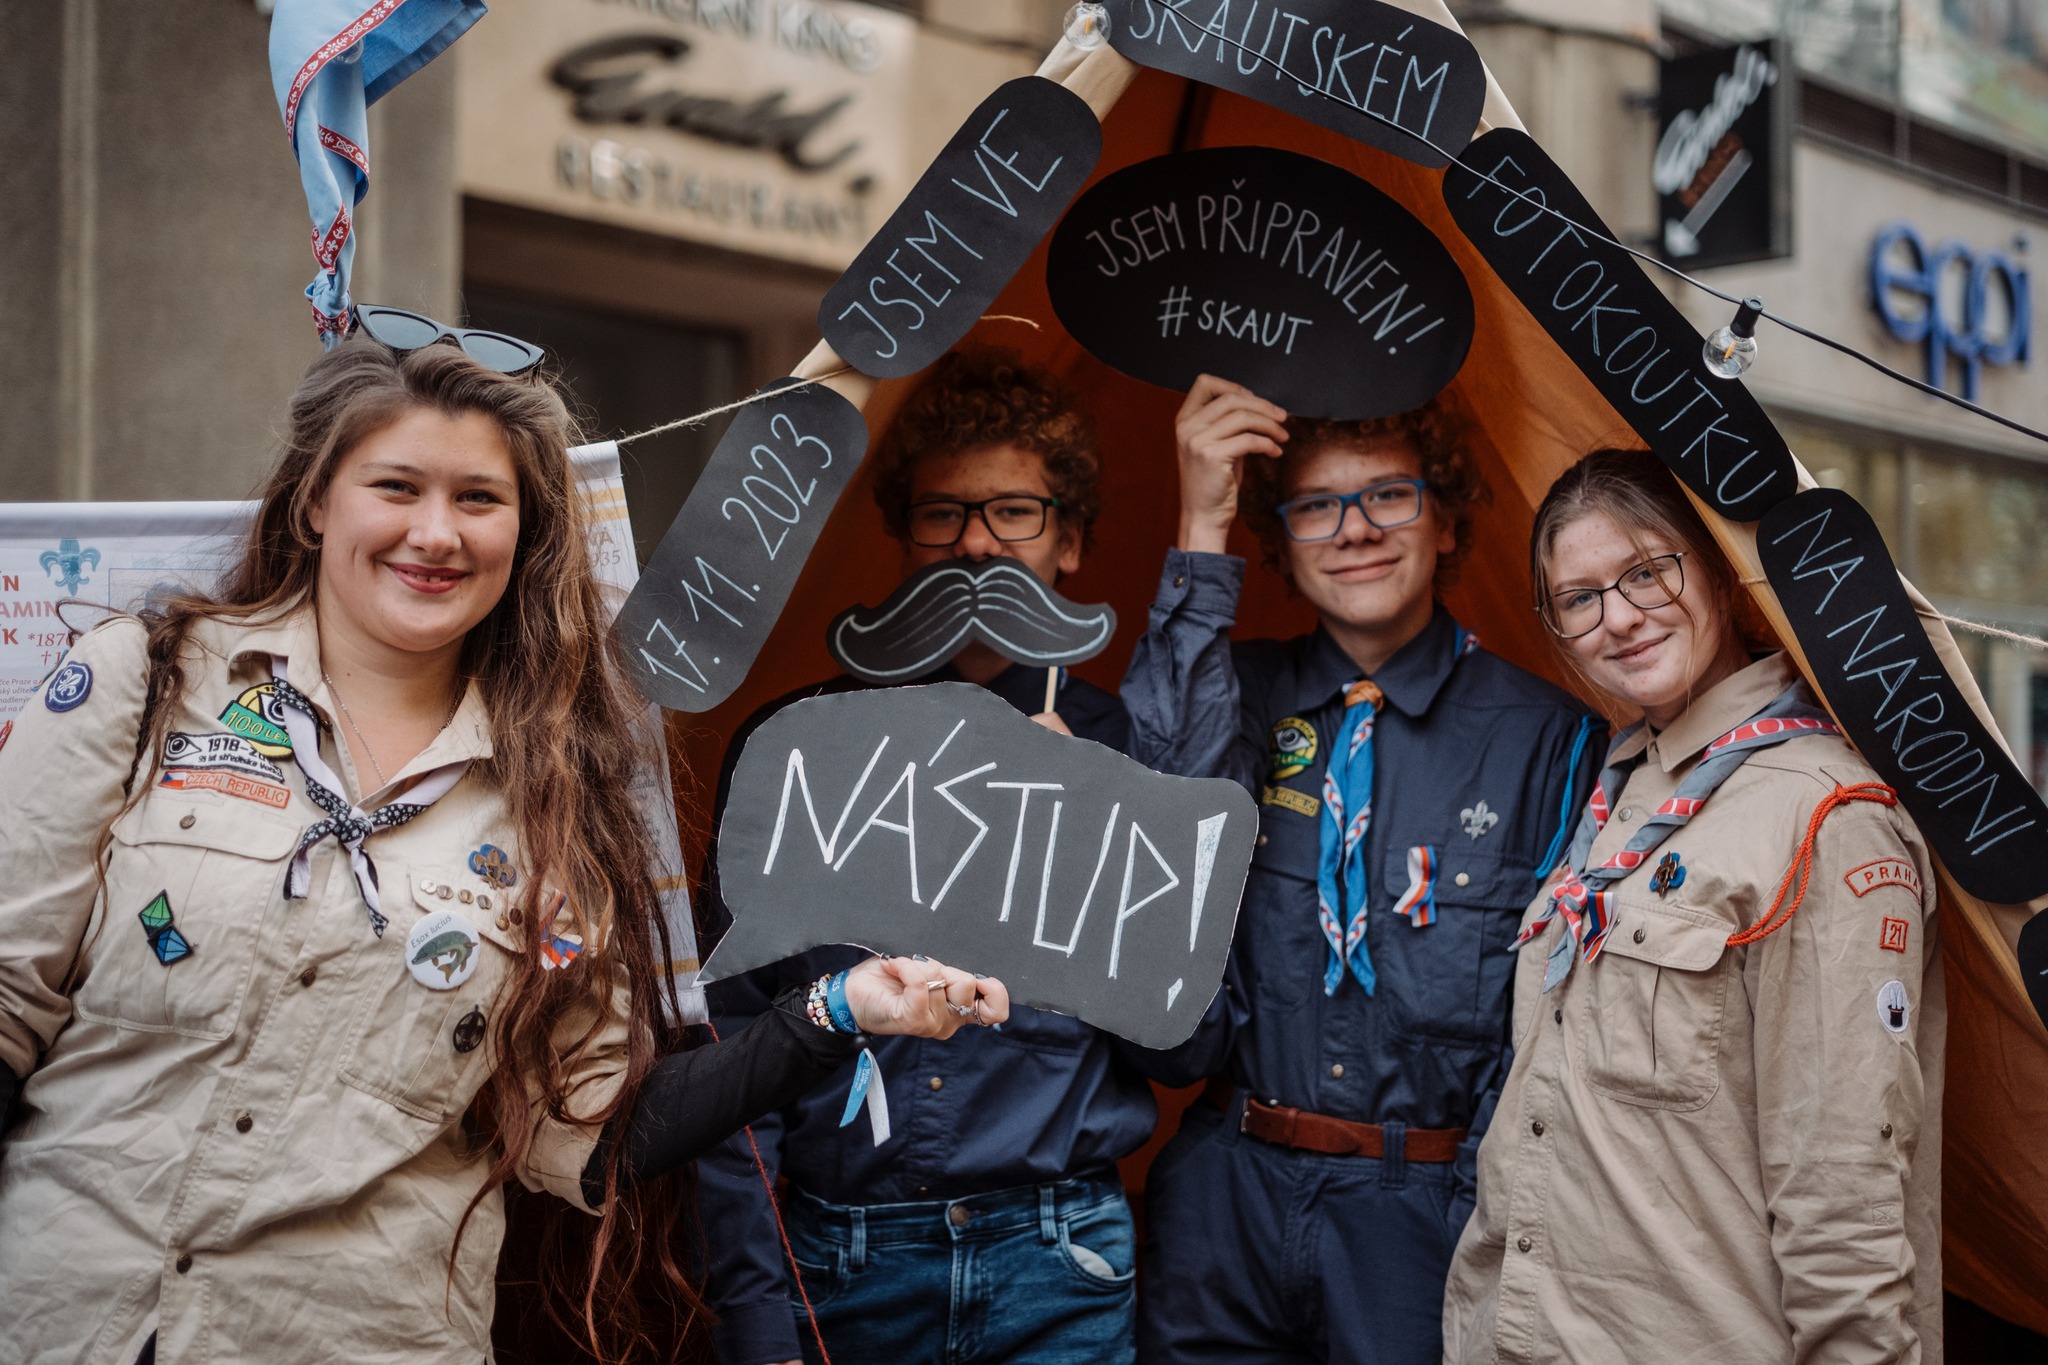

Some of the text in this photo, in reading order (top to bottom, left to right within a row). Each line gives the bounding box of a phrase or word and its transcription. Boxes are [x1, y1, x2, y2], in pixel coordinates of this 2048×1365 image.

[838, 108, 1063, 358] JSEM VE
[1085, 178, 1445, 355] JSEM PŘIPRAVEN!
[1467, 156, 1777, 504] FOTOKOUTKU
[1870, 220, 2032, 400] eppi
[639, 413, 832, 694] 17. 11. 2023
[1772, 509, 1864, 615] NA
[186, 774, 284, 803] CZECH REPUBLIC
[226, 710, 263, 736] 100
[411, 914, 452, 949] Esox lucius
[763, 719, 1228, 1011] NÁSTUP!
[1863, 865, 1919, 891] PRAHA
[1889, 923, 1902, 946] 21
